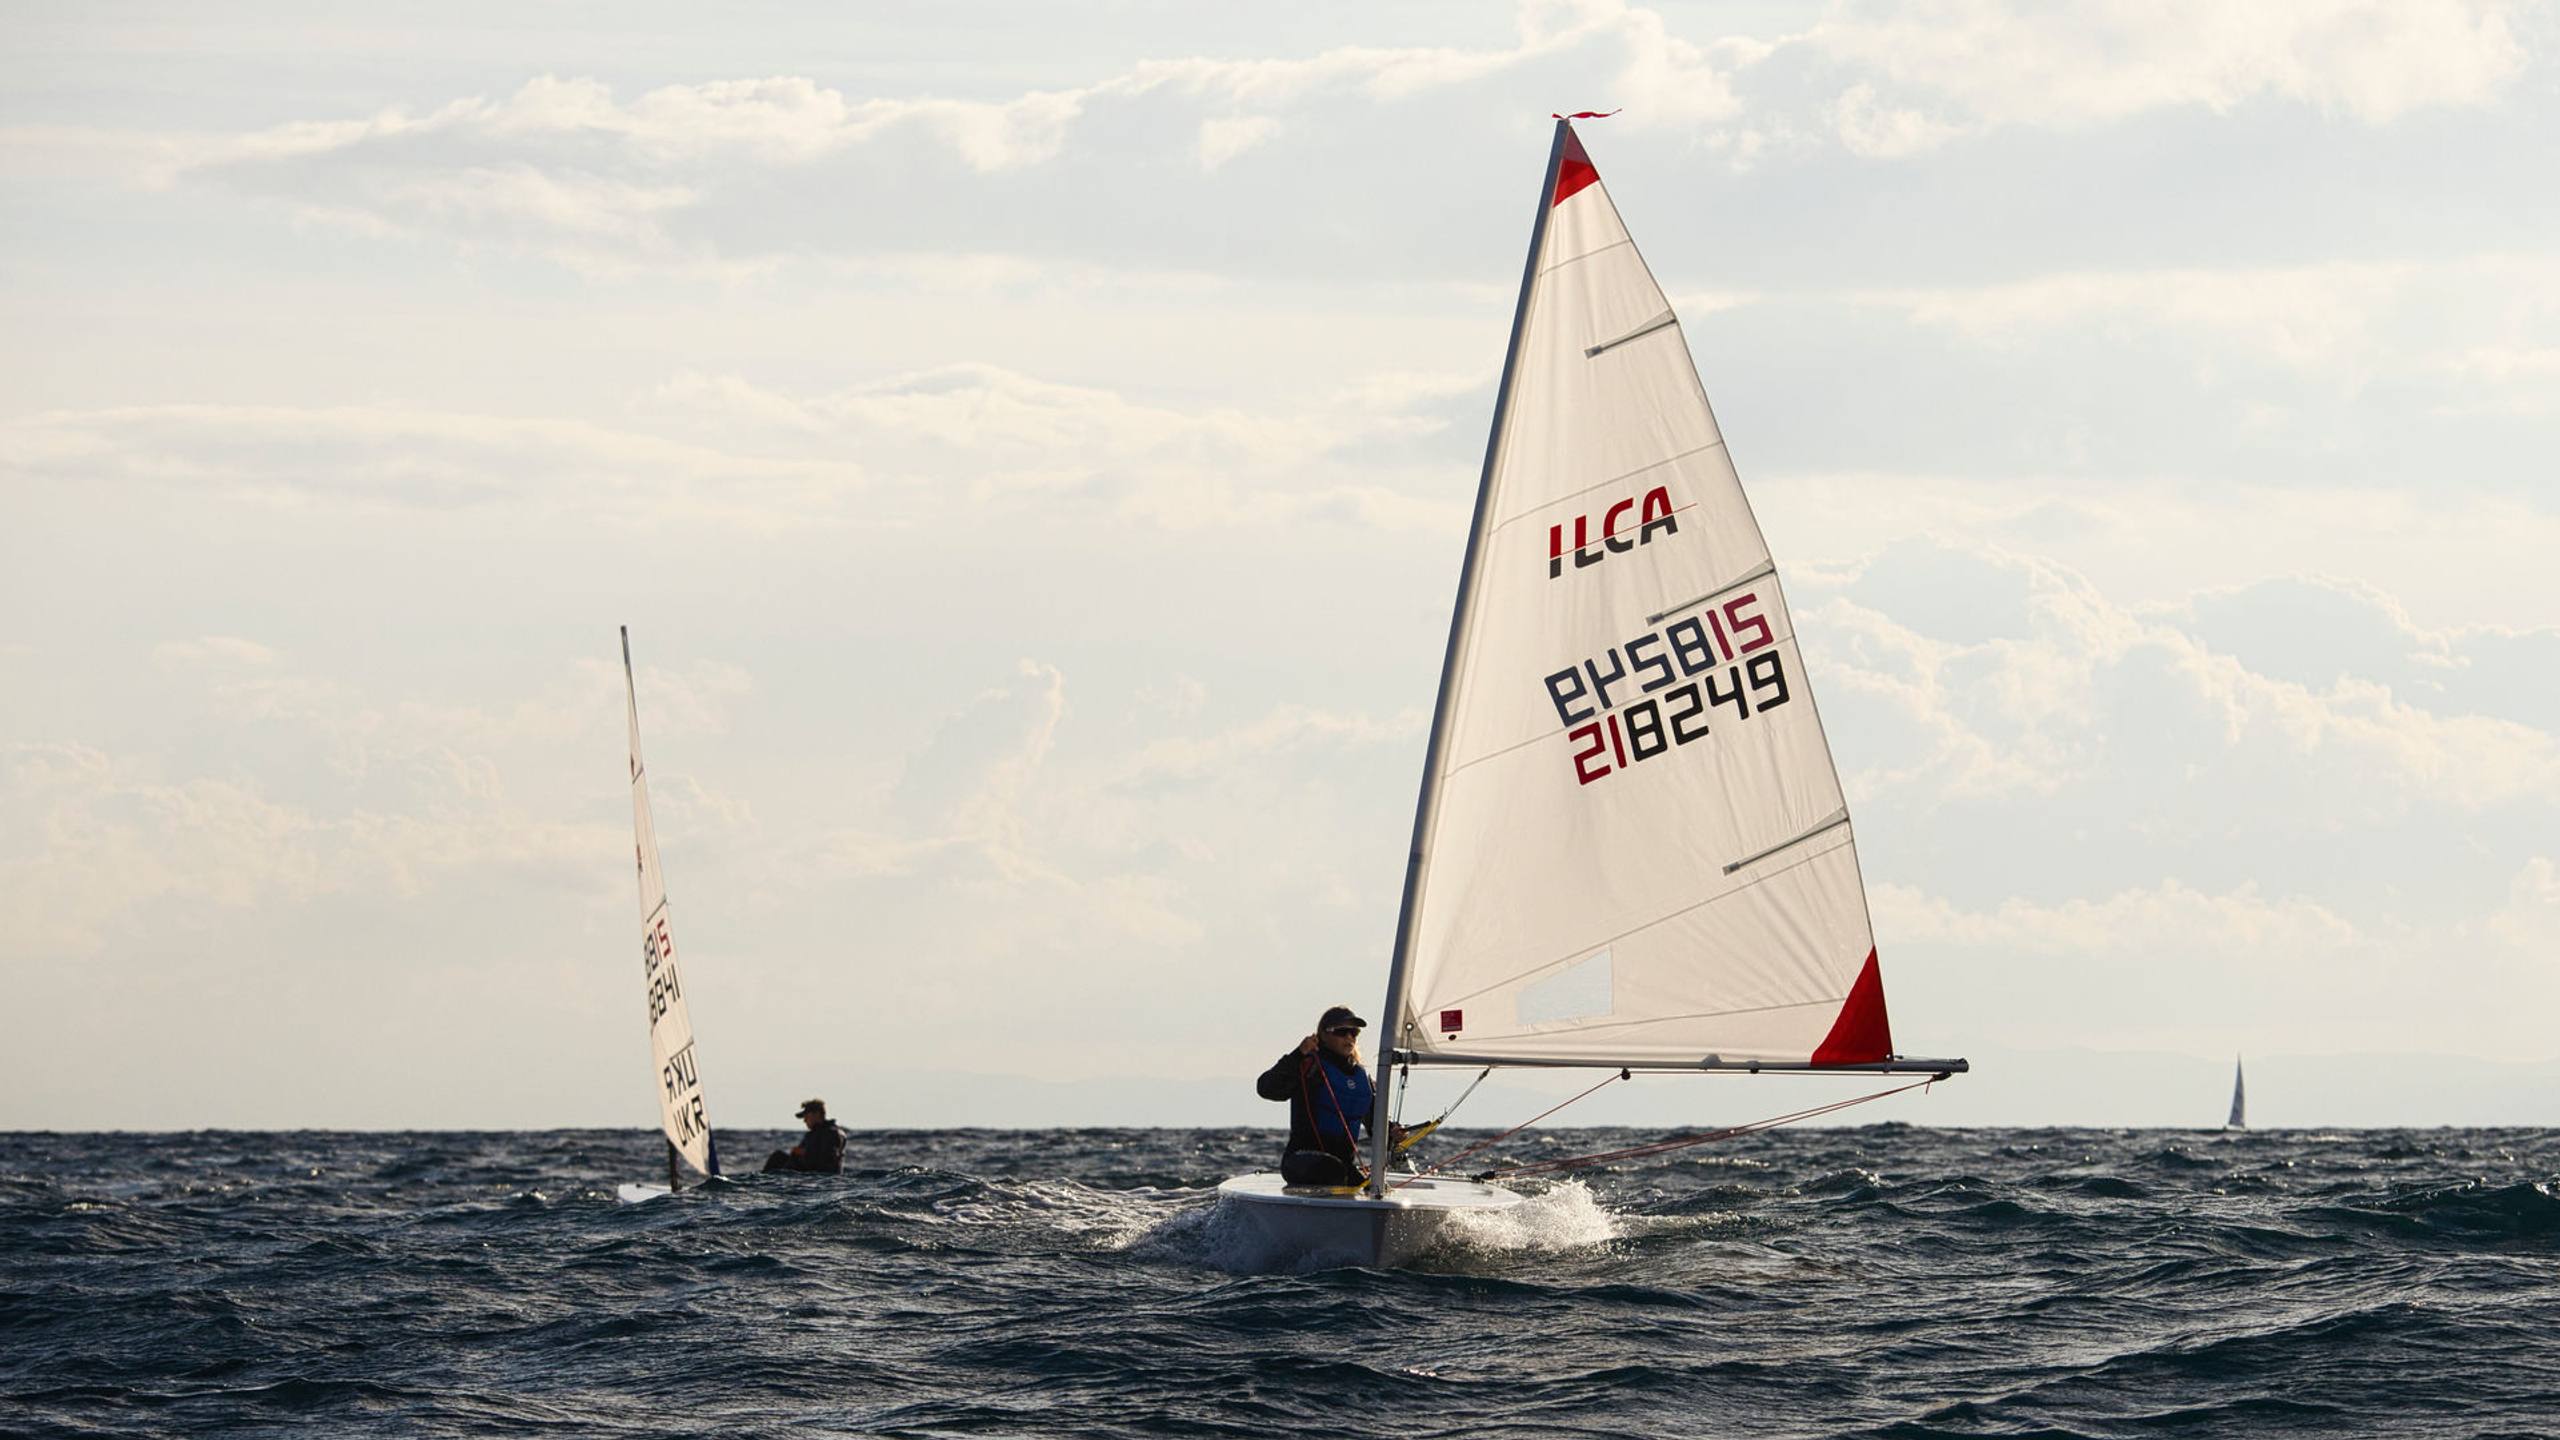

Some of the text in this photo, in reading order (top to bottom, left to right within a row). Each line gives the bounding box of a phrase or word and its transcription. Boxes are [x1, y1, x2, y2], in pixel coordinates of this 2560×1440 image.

[1549, 485, 1679, 580] ILCA
[1568, 649, 1791, 786] 218249
[673, 1094, 707, 1148] UKR
